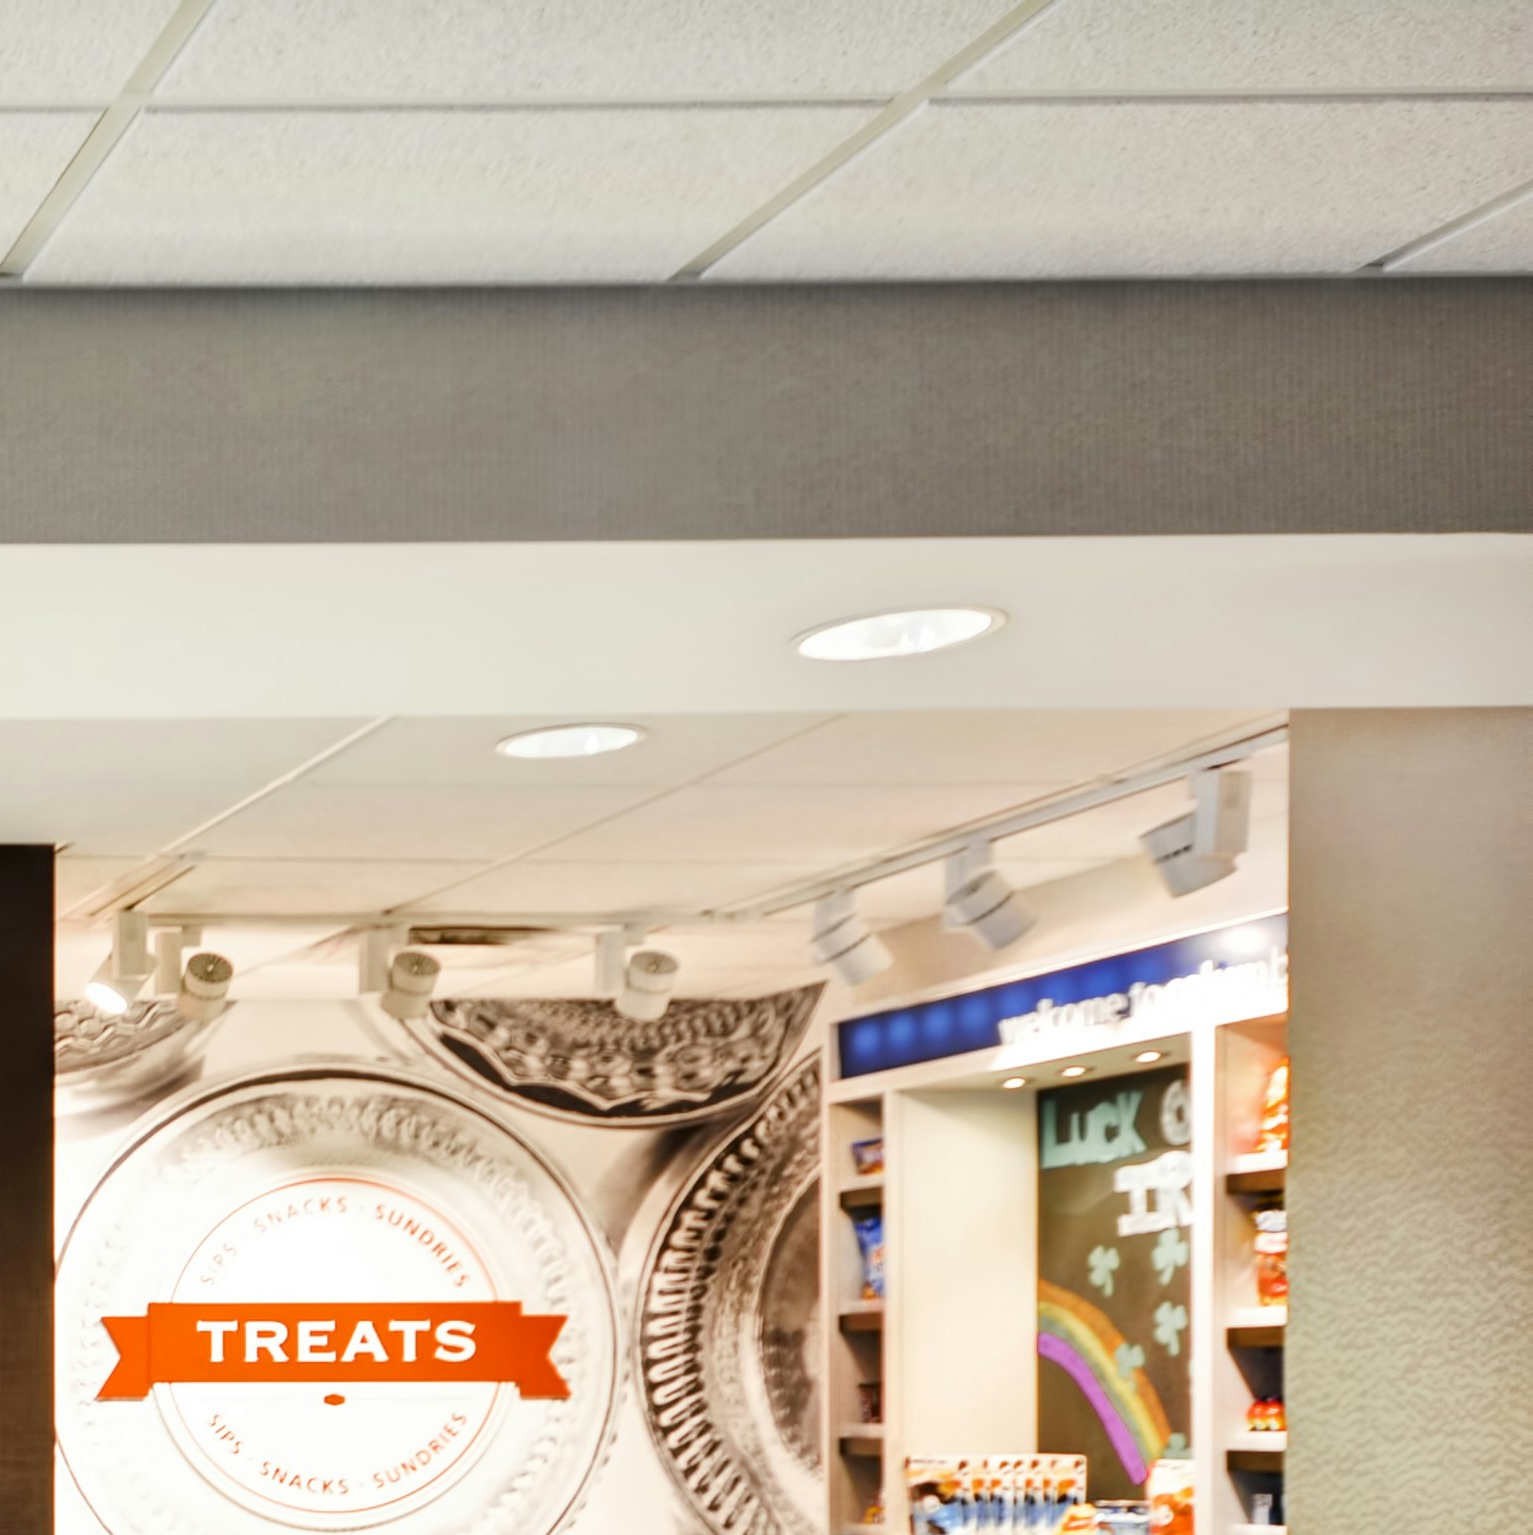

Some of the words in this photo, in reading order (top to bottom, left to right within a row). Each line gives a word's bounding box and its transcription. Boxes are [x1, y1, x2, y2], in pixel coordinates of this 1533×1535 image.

[253, 1195, 349, 1233] SNACKS
[374, 1202, 471, 1288] SUNDRIES
[196, 1319, 478, 1363] TREATS
[206, 1412, 246, 1455] SIPS
[258, 1459, 351, 1496] SNACKS
[371, 1411, 469, 1490] SUNDRIES
